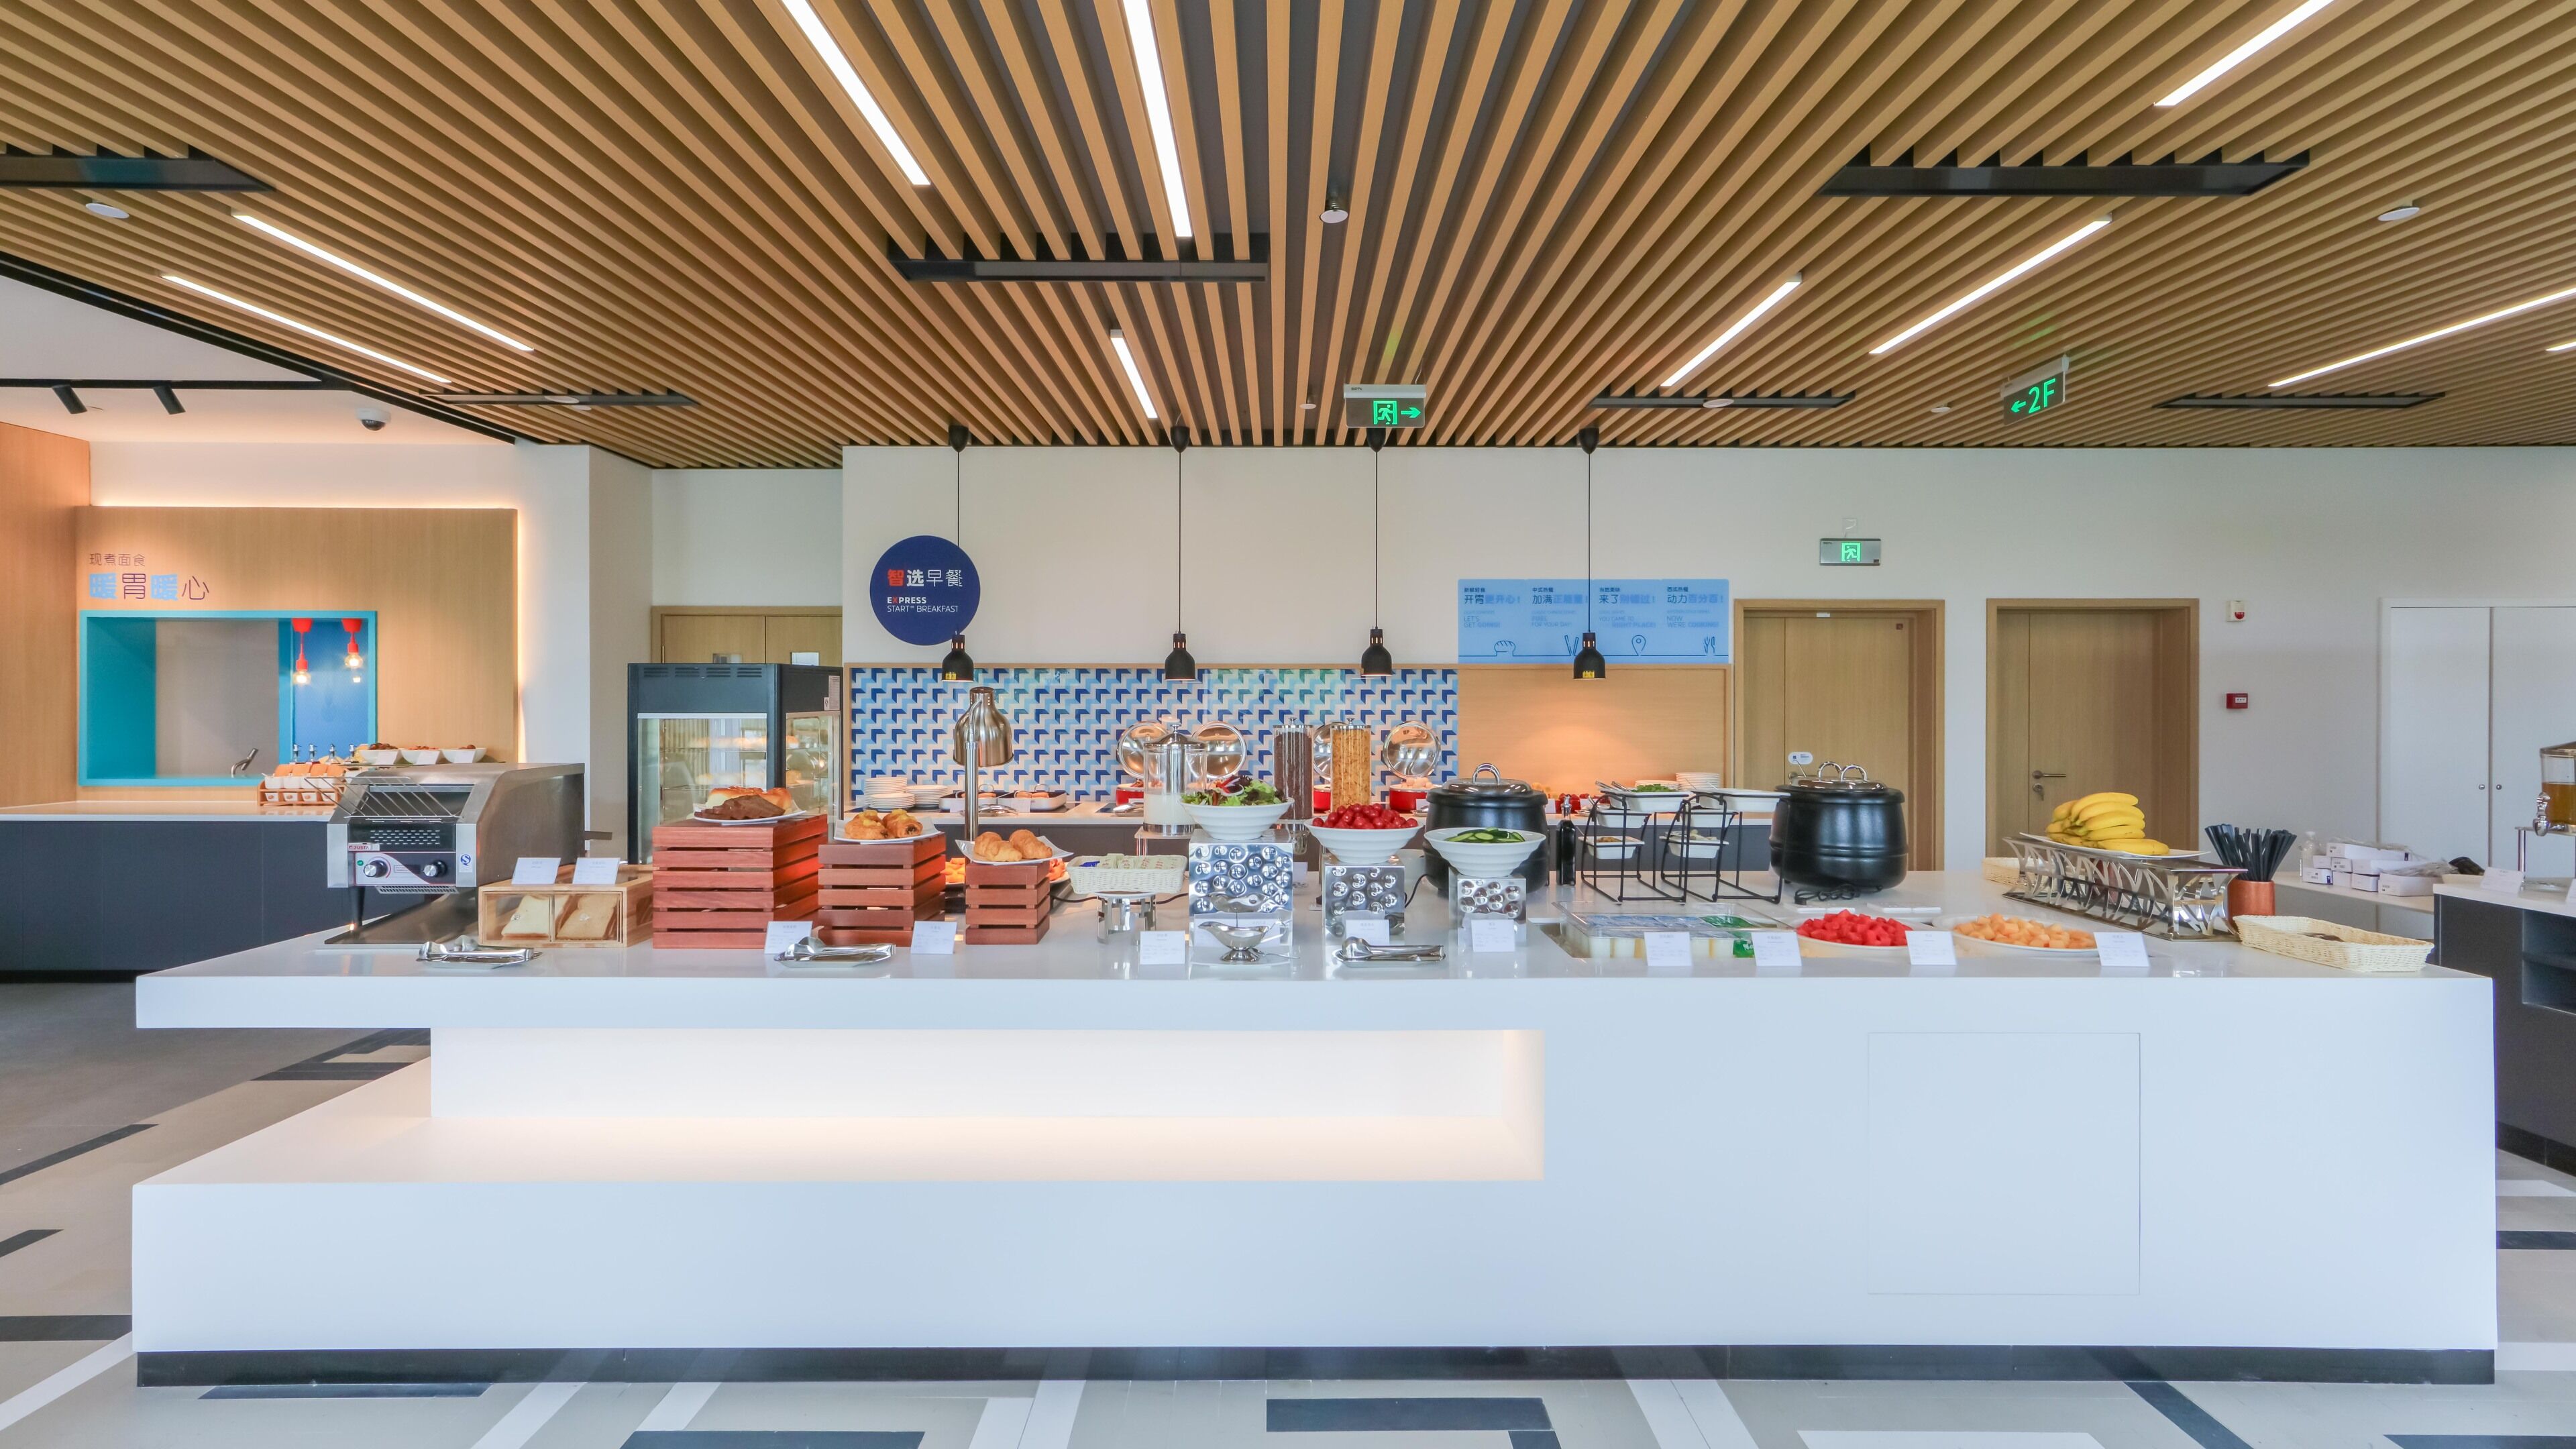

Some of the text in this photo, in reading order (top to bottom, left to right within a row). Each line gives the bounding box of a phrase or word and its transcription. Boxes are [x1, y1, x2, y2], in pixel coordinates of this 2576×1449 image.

[2028, 378, 2056, 414] 2F
[89, 553, 146, 567] 现煮面食
[89, 572, 209, 601] 暖胃暖心
[888, 569, 963, 587] 智选早餐
